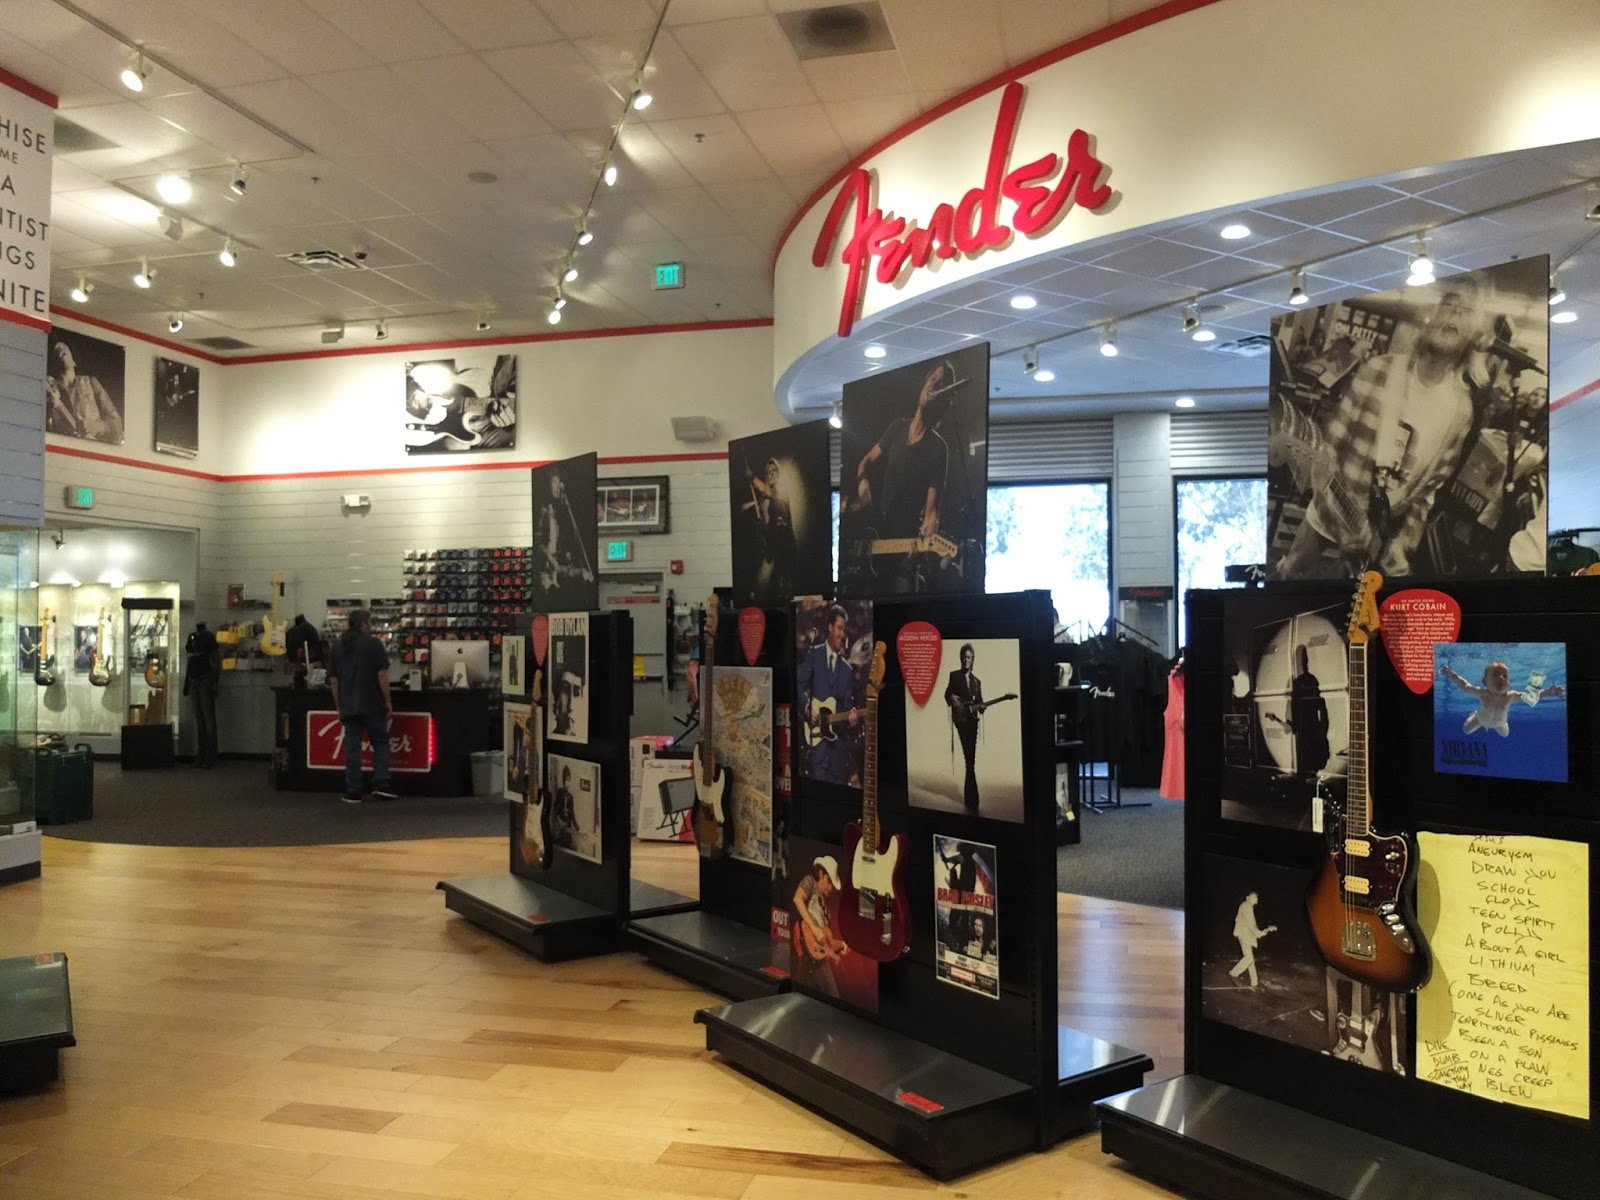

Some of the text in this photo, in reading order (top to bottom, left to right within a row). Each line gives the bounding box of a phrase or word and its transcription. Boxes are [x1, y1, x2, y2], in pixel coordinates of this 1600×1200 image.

[1, 174, 15, 195] A
[812, 81, 1112, 337] Fender
[0, 207, 48, 240] TIST
[0, 242, 34, 270] GS
[1390, 602, 1446, 611] KURT COBAIN
[1471, 861, 1556, 884] DRAW YOU
[1476, 880, 1536, 896] SCHOOL
[772, 910, 789, 926] OUT
[1469, 906, 1556, 931] TEEN SPIRIT
[1515, 945, 1526, 957] A
[1534, 951, 1566, 963] GIRL
[1469, 954, 1535, 977] LITHIUM
[1467, 973, 1528, 993] BREED
[1448, 979, 1484, 1001] COME
[1493, 995, 1509, 1008] AS
[1546, 1004, 1572, 1021] ARE
[1475, 1007, 1526, 1026] SLIVER
[1425, 1040, 1450, 1052] DIVE
[1459, 1028, 1543, 1059] BEEN A SON
[1432, 1053, 1461, 1067] DUMB
[1470, 1050, 1490, 1060] ON
[1498, 1054, 1507, 1063] A
[1486, 1078, 1533, 1099] BLEW
[1513, 1073, 1554, 1087] CREEP
